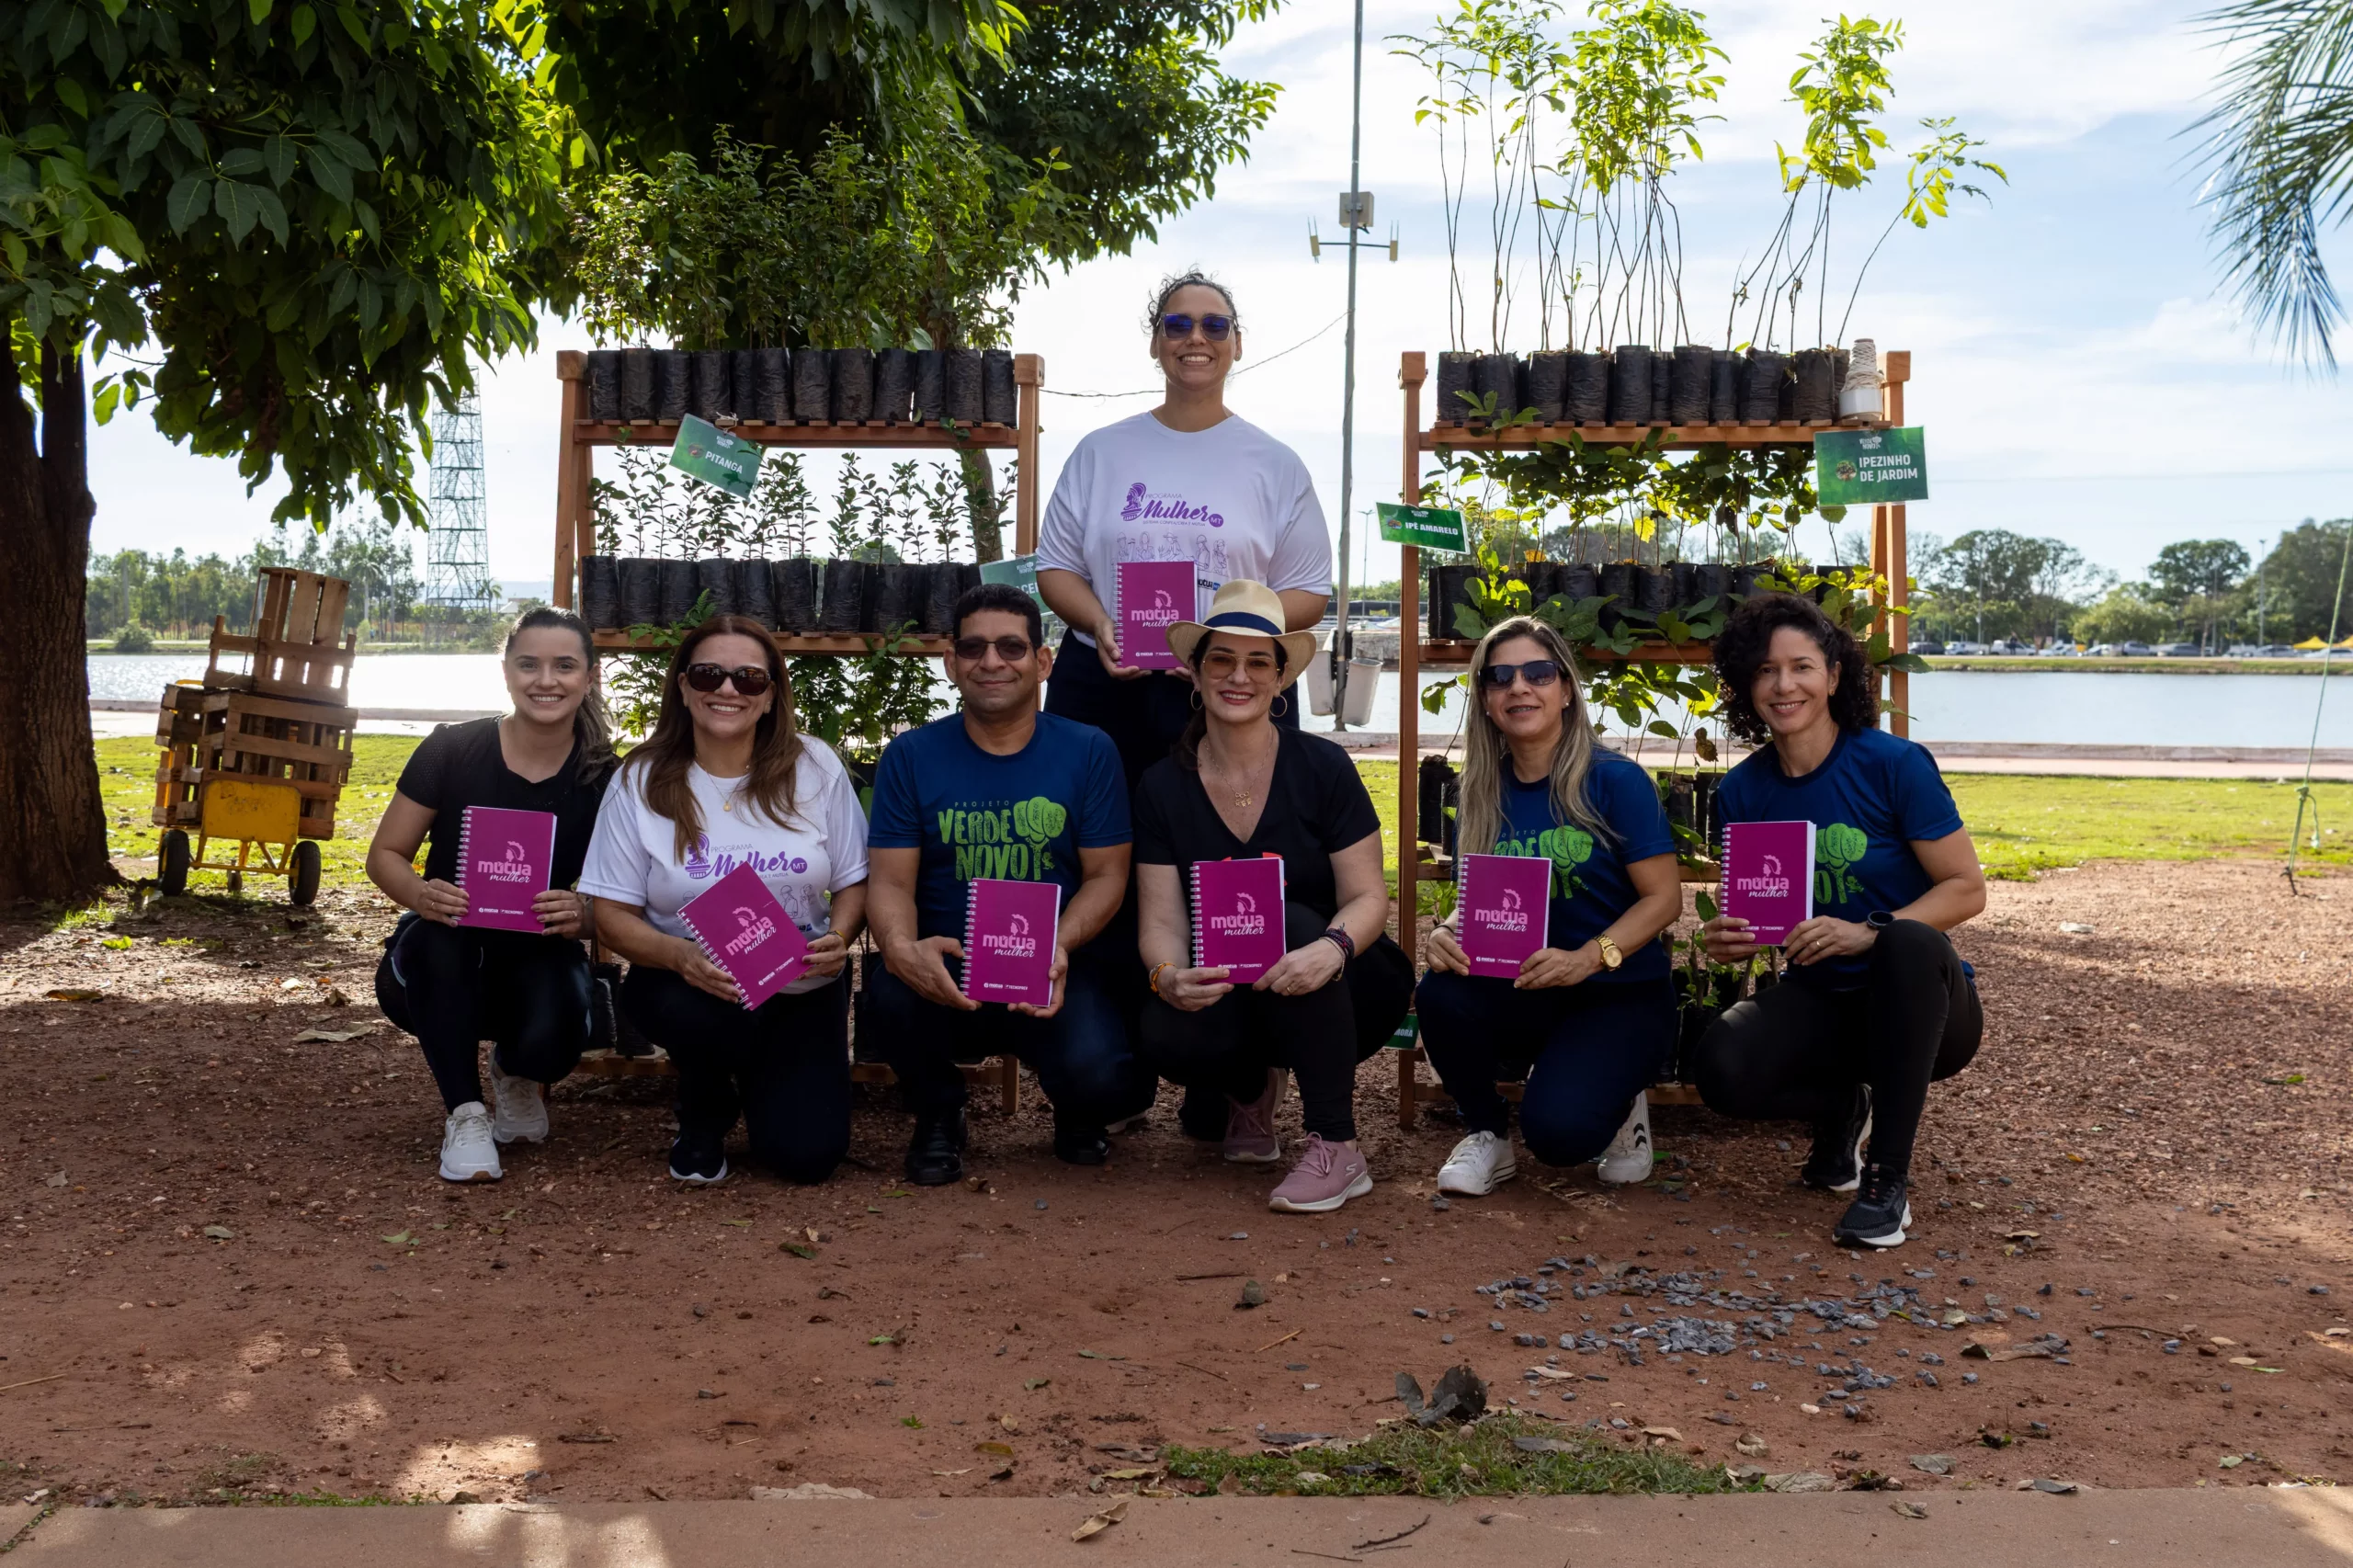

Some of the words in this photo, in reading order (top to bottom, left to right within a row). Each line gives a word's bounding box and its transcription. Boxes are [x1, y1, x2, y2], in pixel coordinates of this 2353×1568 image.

[705, 450, 743, 473] PITANGA
[1859, 454, 1911, 468] IPEZINHO
[1860, 471, 1874, 482] DE
[1877, 468, 1917, 483] JARDIM
[1140, 500, 1211, 522] Mulher
[1404, 522, 1418, 530] IPÊ
[1420, 525, 1458, 535] AMARELO
[938, 808, 1014, 844] VERDE
[711, 844, 754, 853] PROGRAMA
[956, 844, 1029, 881] NOVO
[489, 871, 531, 883] mulher
[1748, 886, 1789, 898] mulher
[1224, 924, 1265, 936] mulher
[1486, 920, 1527, 932] mulher
[745, 926, 776, 954] mulher
[994, 946, 1035, 958] mulher
